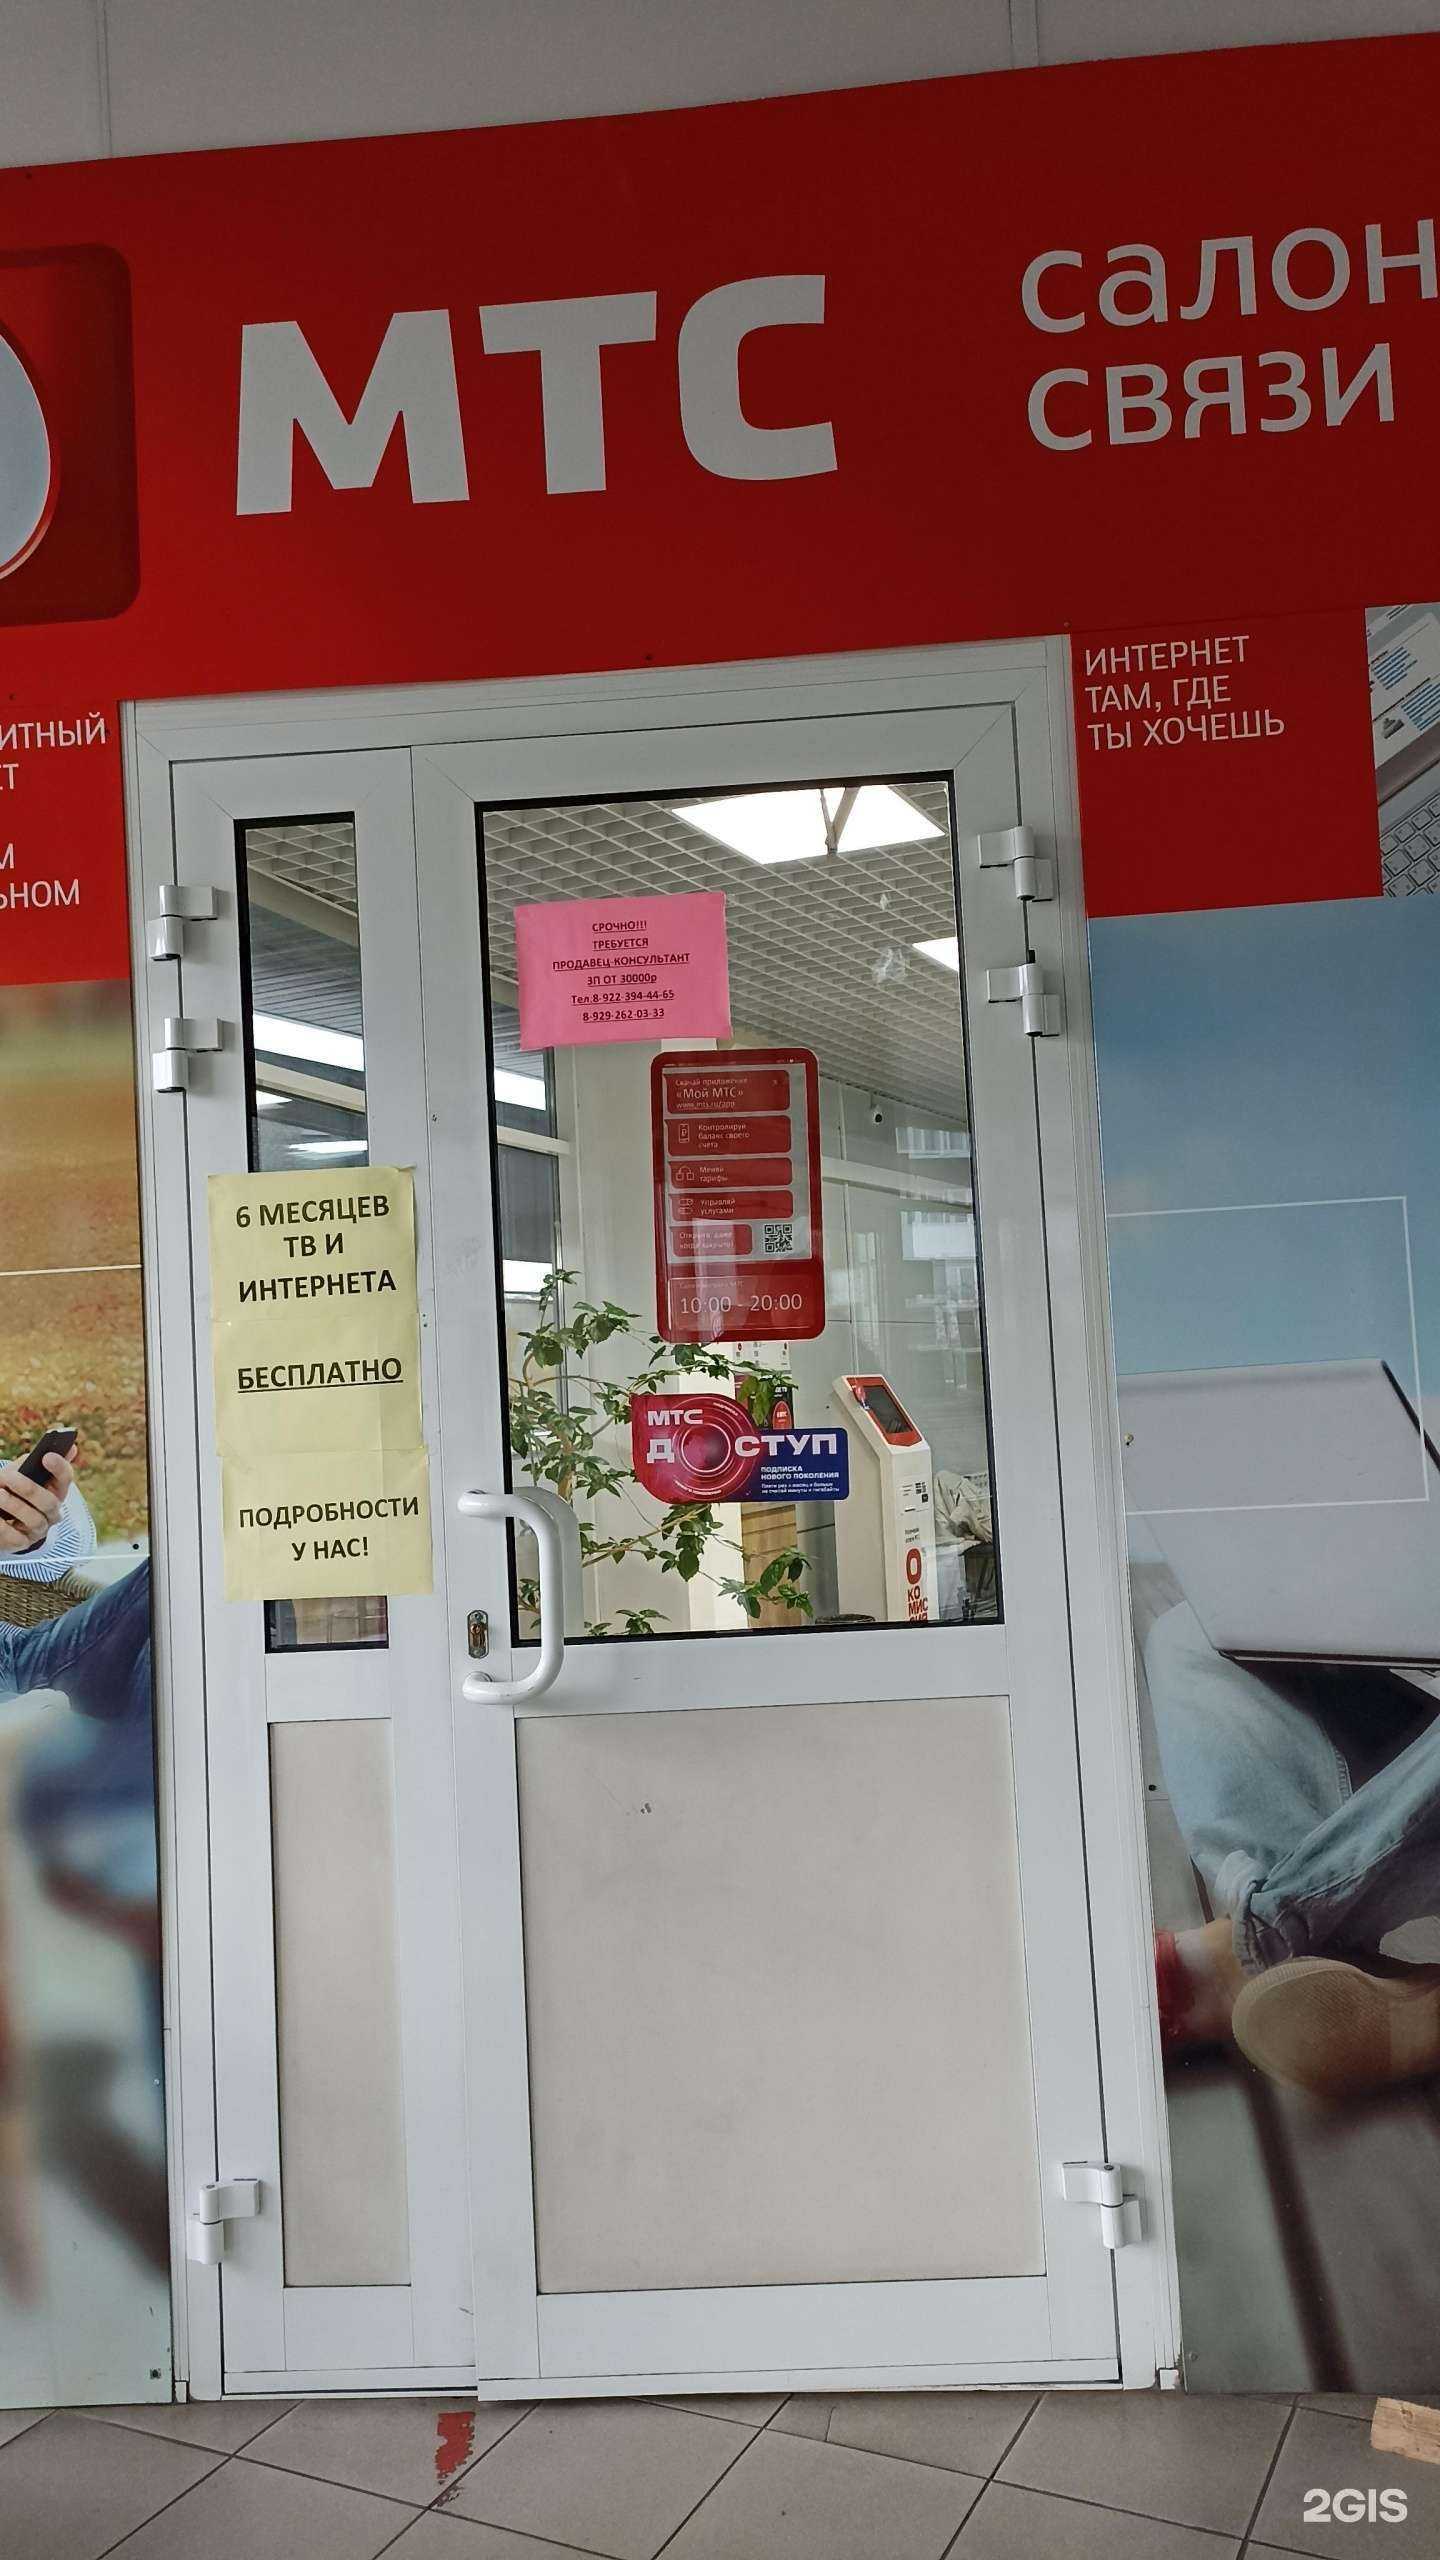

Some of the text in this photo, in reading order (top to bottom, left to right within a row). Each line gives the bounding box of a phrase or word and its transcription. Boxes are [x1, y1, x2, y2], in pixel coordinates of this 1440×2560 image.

[1021, 219, 1439, 333] салон
[237, 275, 838, 515] МТС
[1028, 343, 1395, 451] связи
[1085, 635, 1250, 676] ИНТЕРНЕТ
[1085, 675, 1231, 713] ТАМ, ГДЕ
[1087, 709, 1285, 750] ТЫ ХОЧЕШЬ
[592, 920, 647, 933] СРОЧНО!!!
[593, 937, 649, 950] ТРЕБУЕТСЯ
[552, 953, 690, 971] ПРОДАВЕЦ-КОНСУЛЬТАНТ
[603, 975, 617, 985] ОТ
[620, 973, 657, 984] 30000р
[583, 1008, 665, 1022] 8-929-262-03-33
[236, 1195, 390, 1228] 6 МЕСЯЦЕВ
[284, 1233, 344, 1258] ТВ И
[239, 1269, 396, 1302] ИНТЕРНЕТА
[681, 1296, 731, 1314] 10:00
[750, 1294, 802, 1311] 20:00
[238, 1357, 403, 1391] БЕСПЛАТНО
[647, 1409, 704, 1425] МТС
[239, 1497, 419, 1530] ПОДРОБНОСТИ
[291, 1537, 369, 1561] У НАС!
[907, 1585, 920, 1602] КО
[908, 1597, 928, 1617] МИС
